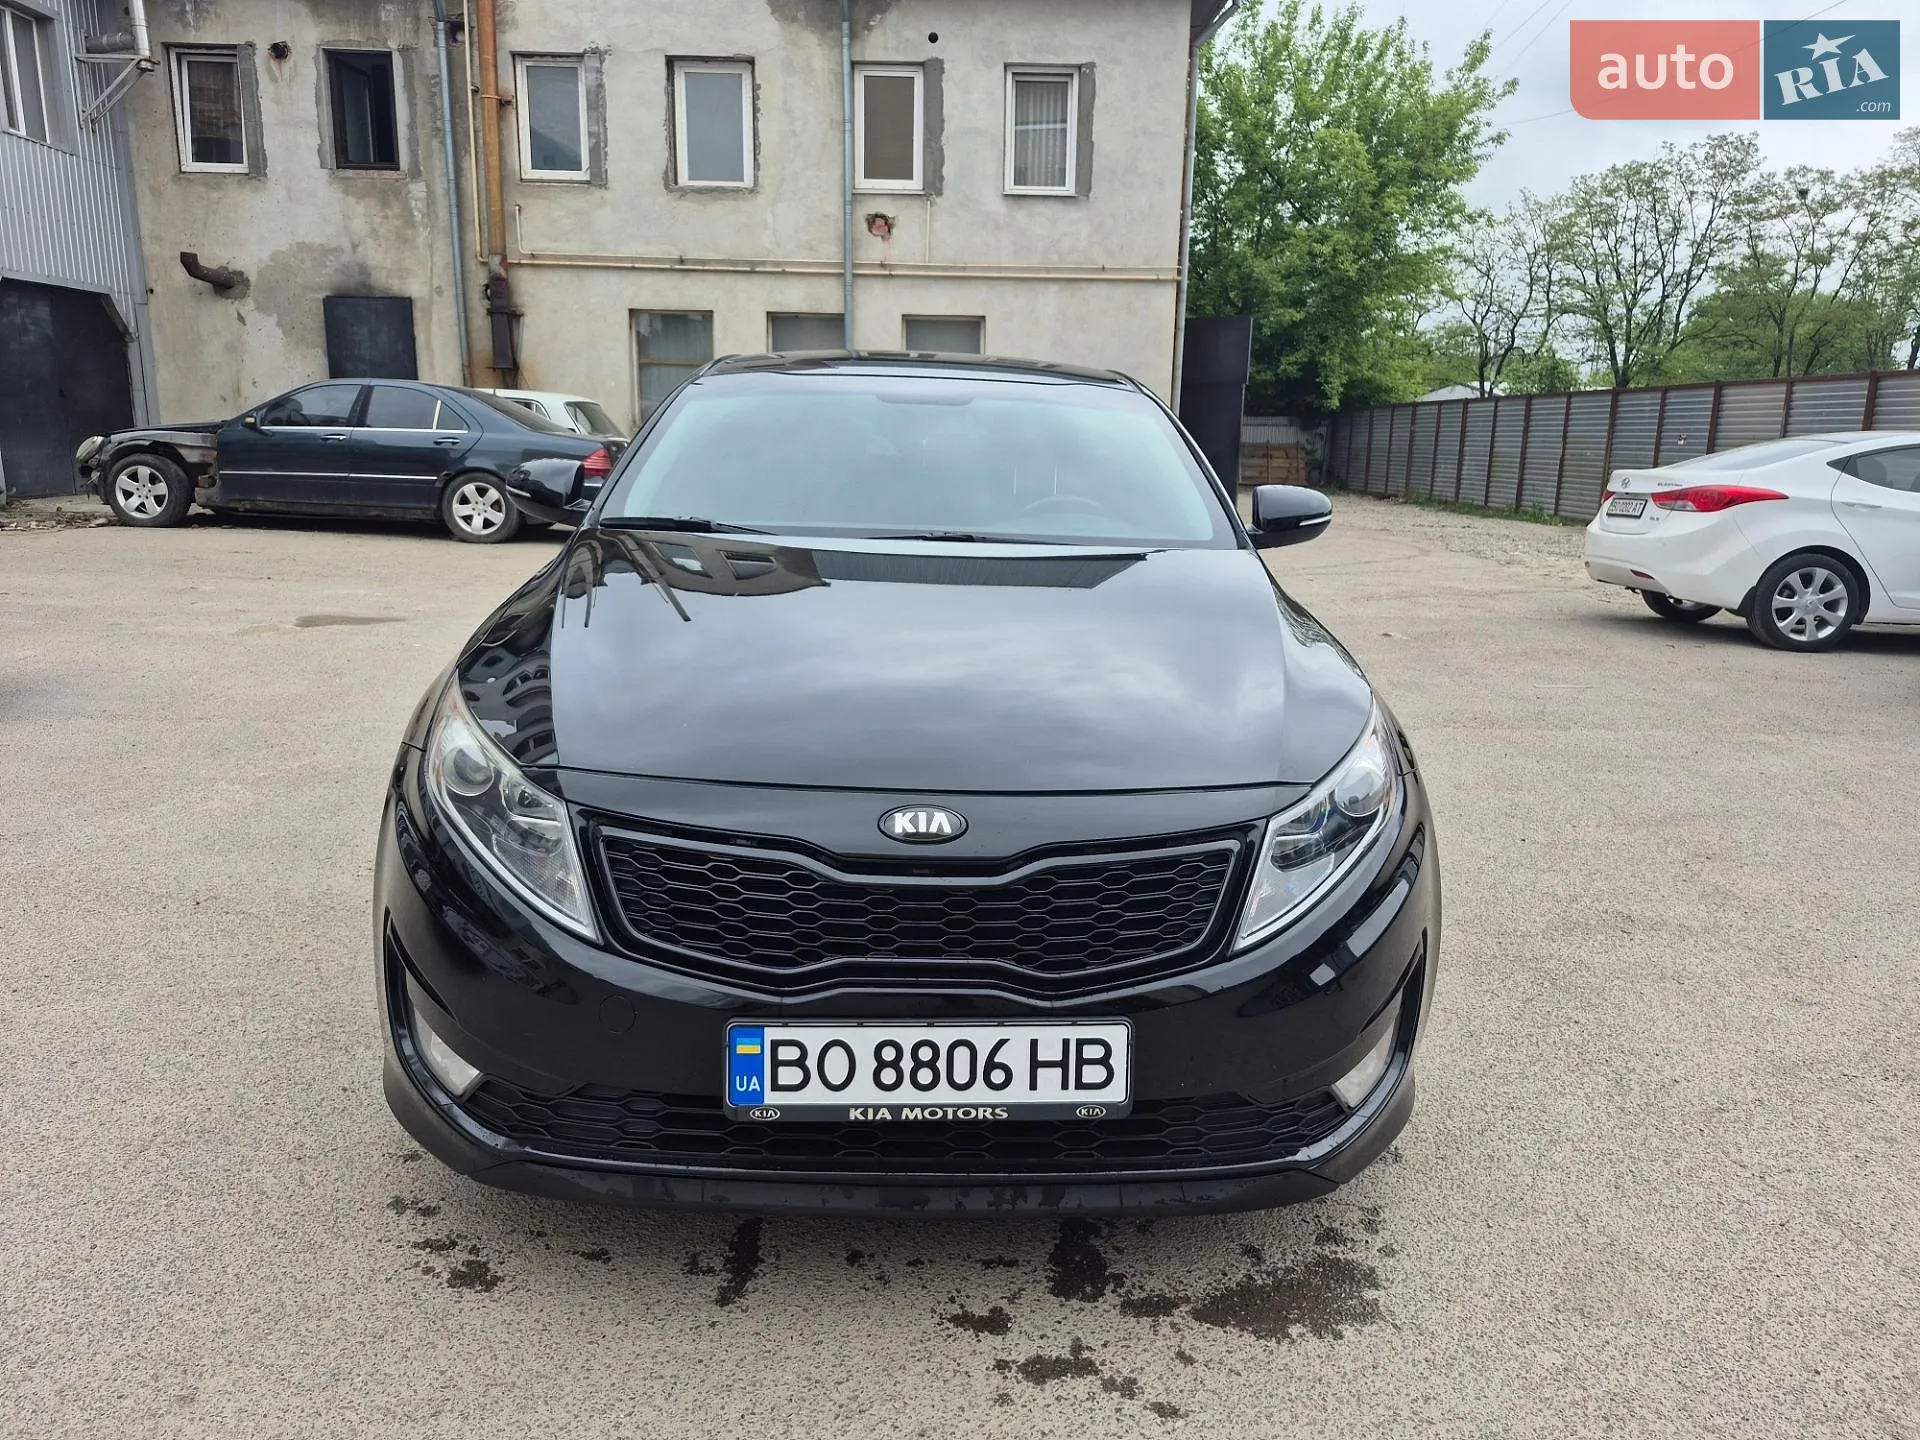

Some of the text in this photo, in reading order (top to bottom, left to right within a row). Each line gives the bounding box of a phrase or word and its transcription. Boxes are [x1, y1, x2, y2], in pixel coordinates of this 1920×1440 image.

[893, 811, 953, 834] KIA
[770, 1037, 1116, 1092] BO 8806 HB
[736, 1075, 761, 1092] UA
[754, 1110, 776, 1118] KIA
[849, 1107, 1009, 1120] KIA MOTORS
[1081, 1108, 1101, 1116] KIA
